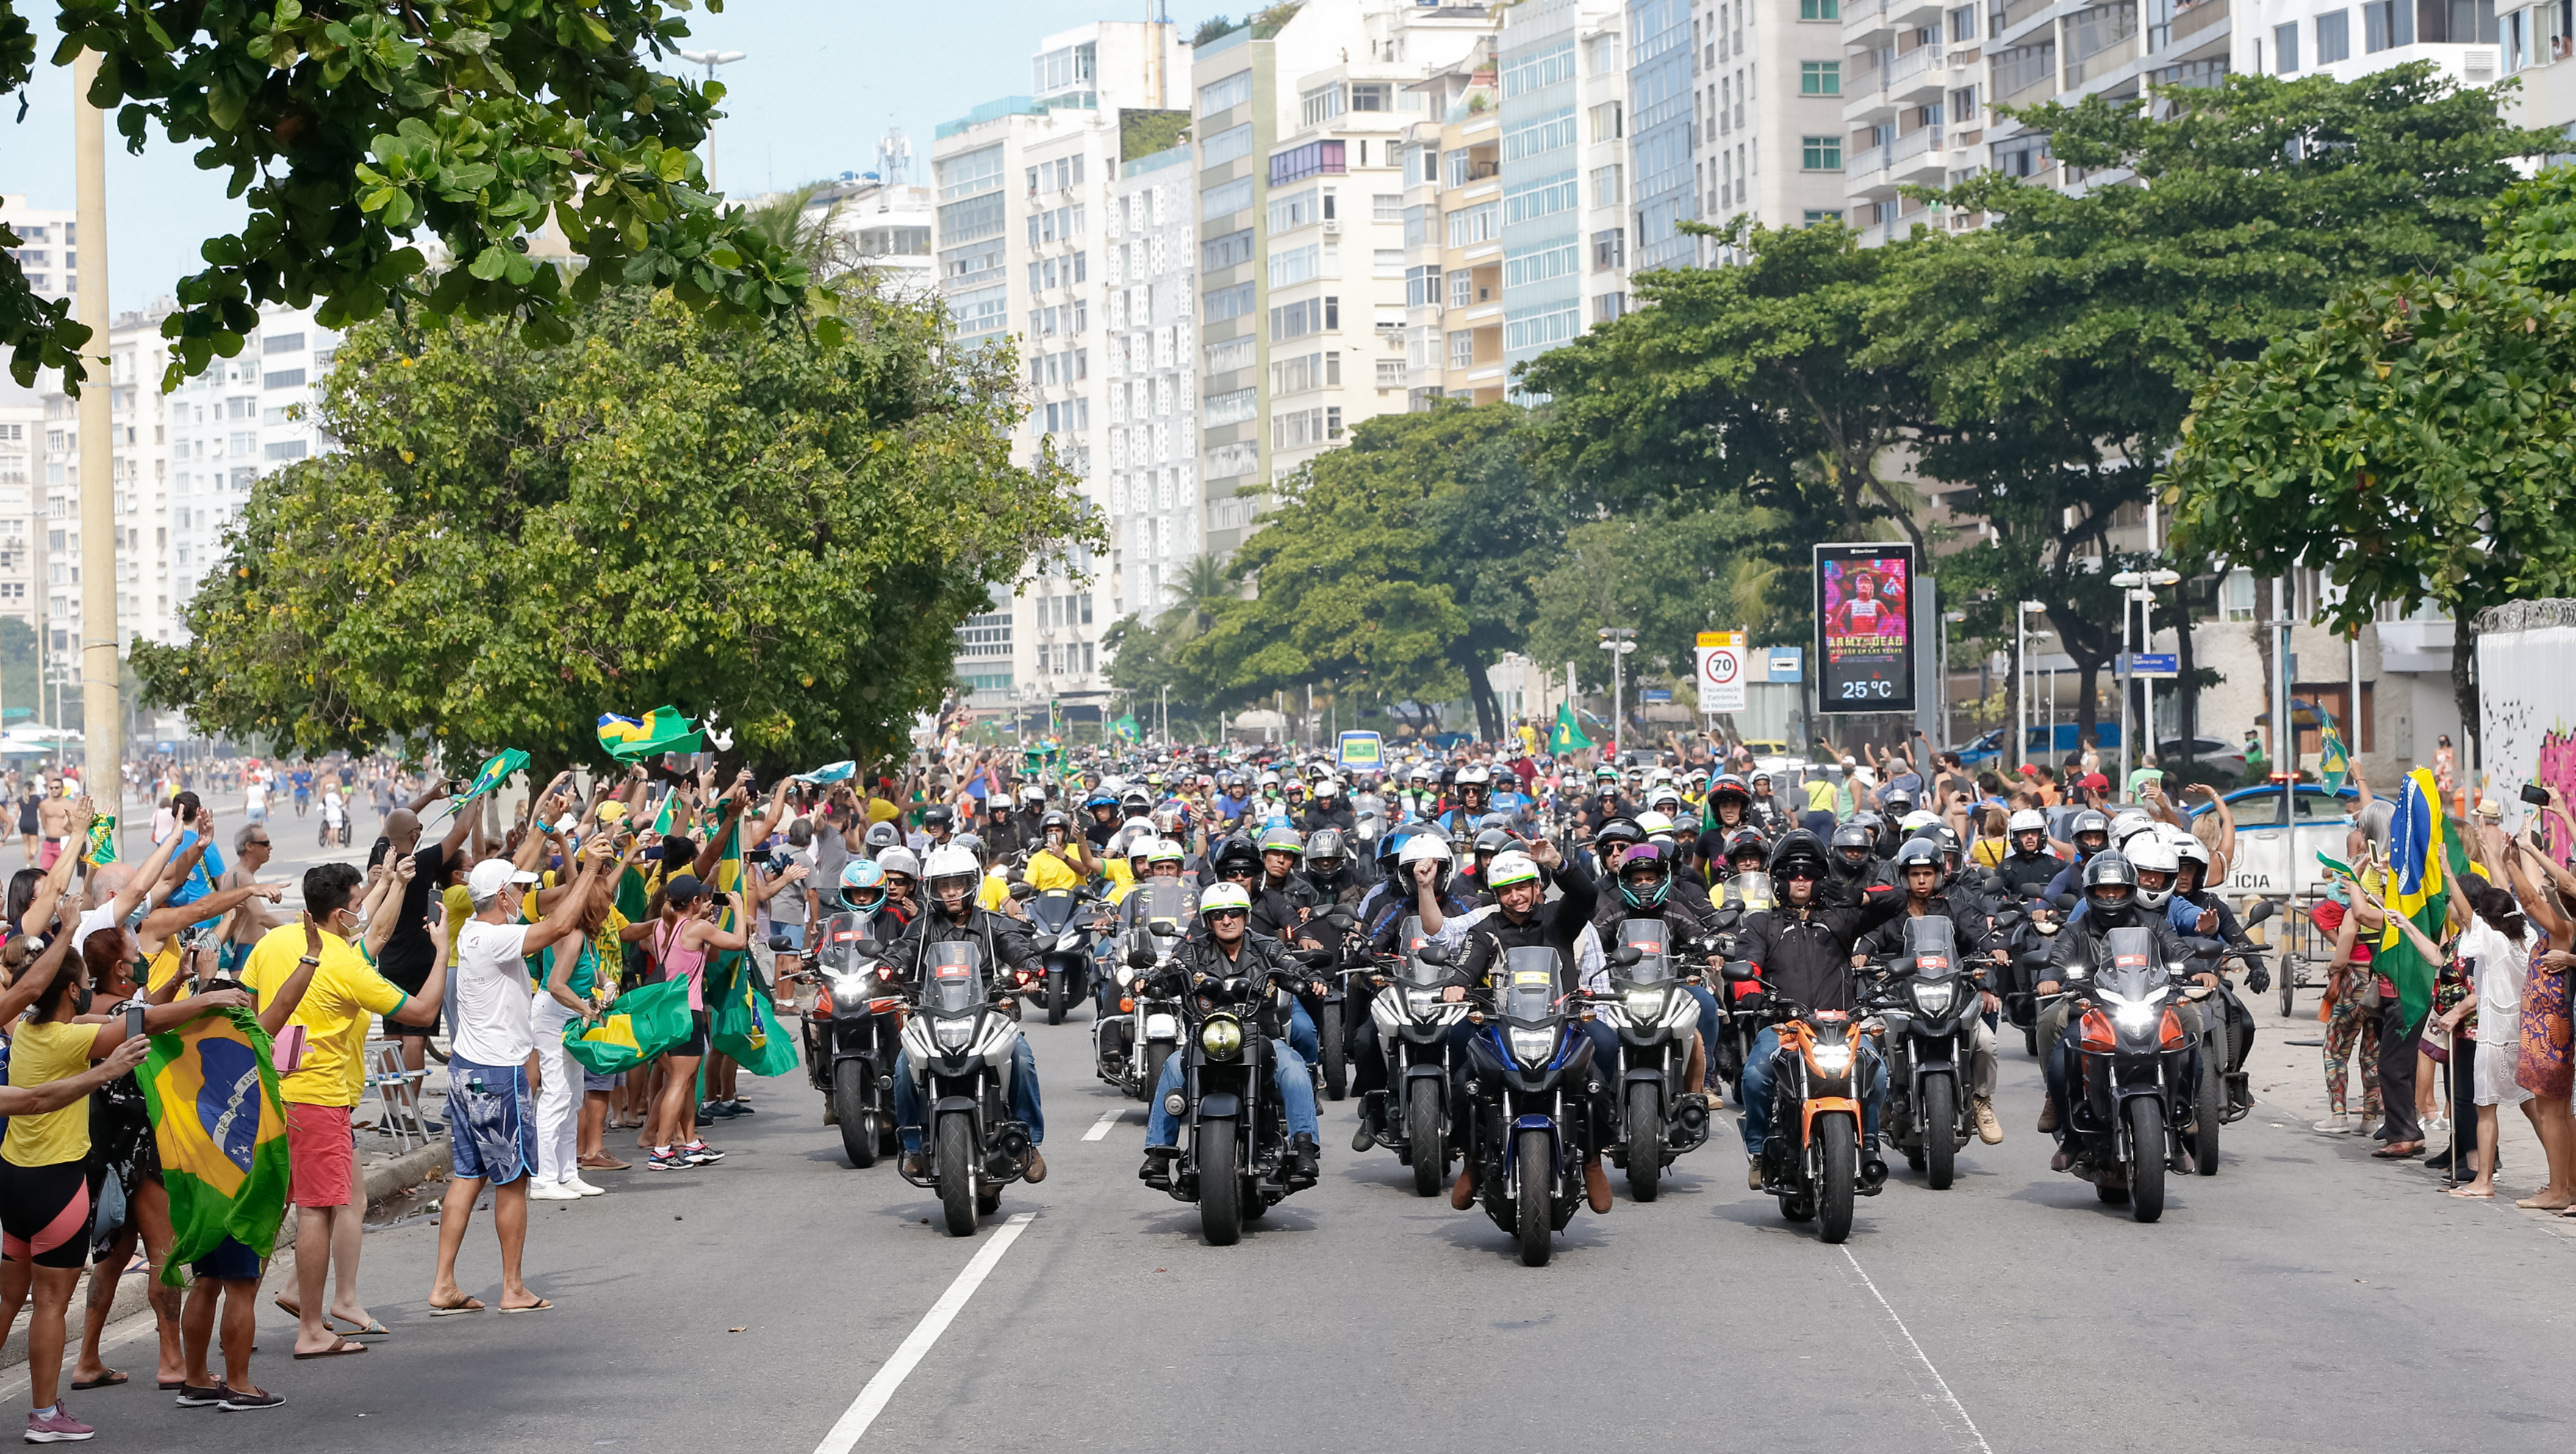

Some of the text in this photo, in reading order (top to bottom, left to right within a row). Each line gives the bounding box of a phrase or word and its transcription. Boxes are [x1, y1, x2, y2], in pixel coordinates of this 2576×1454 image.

[1829, 636, 1903, 647] ARMY DEAD
[1713, 659, 1732, 671] 70
[1842, 681, 1868, 698] 25
[2227, 870, 2270, 888] ÍCIA
